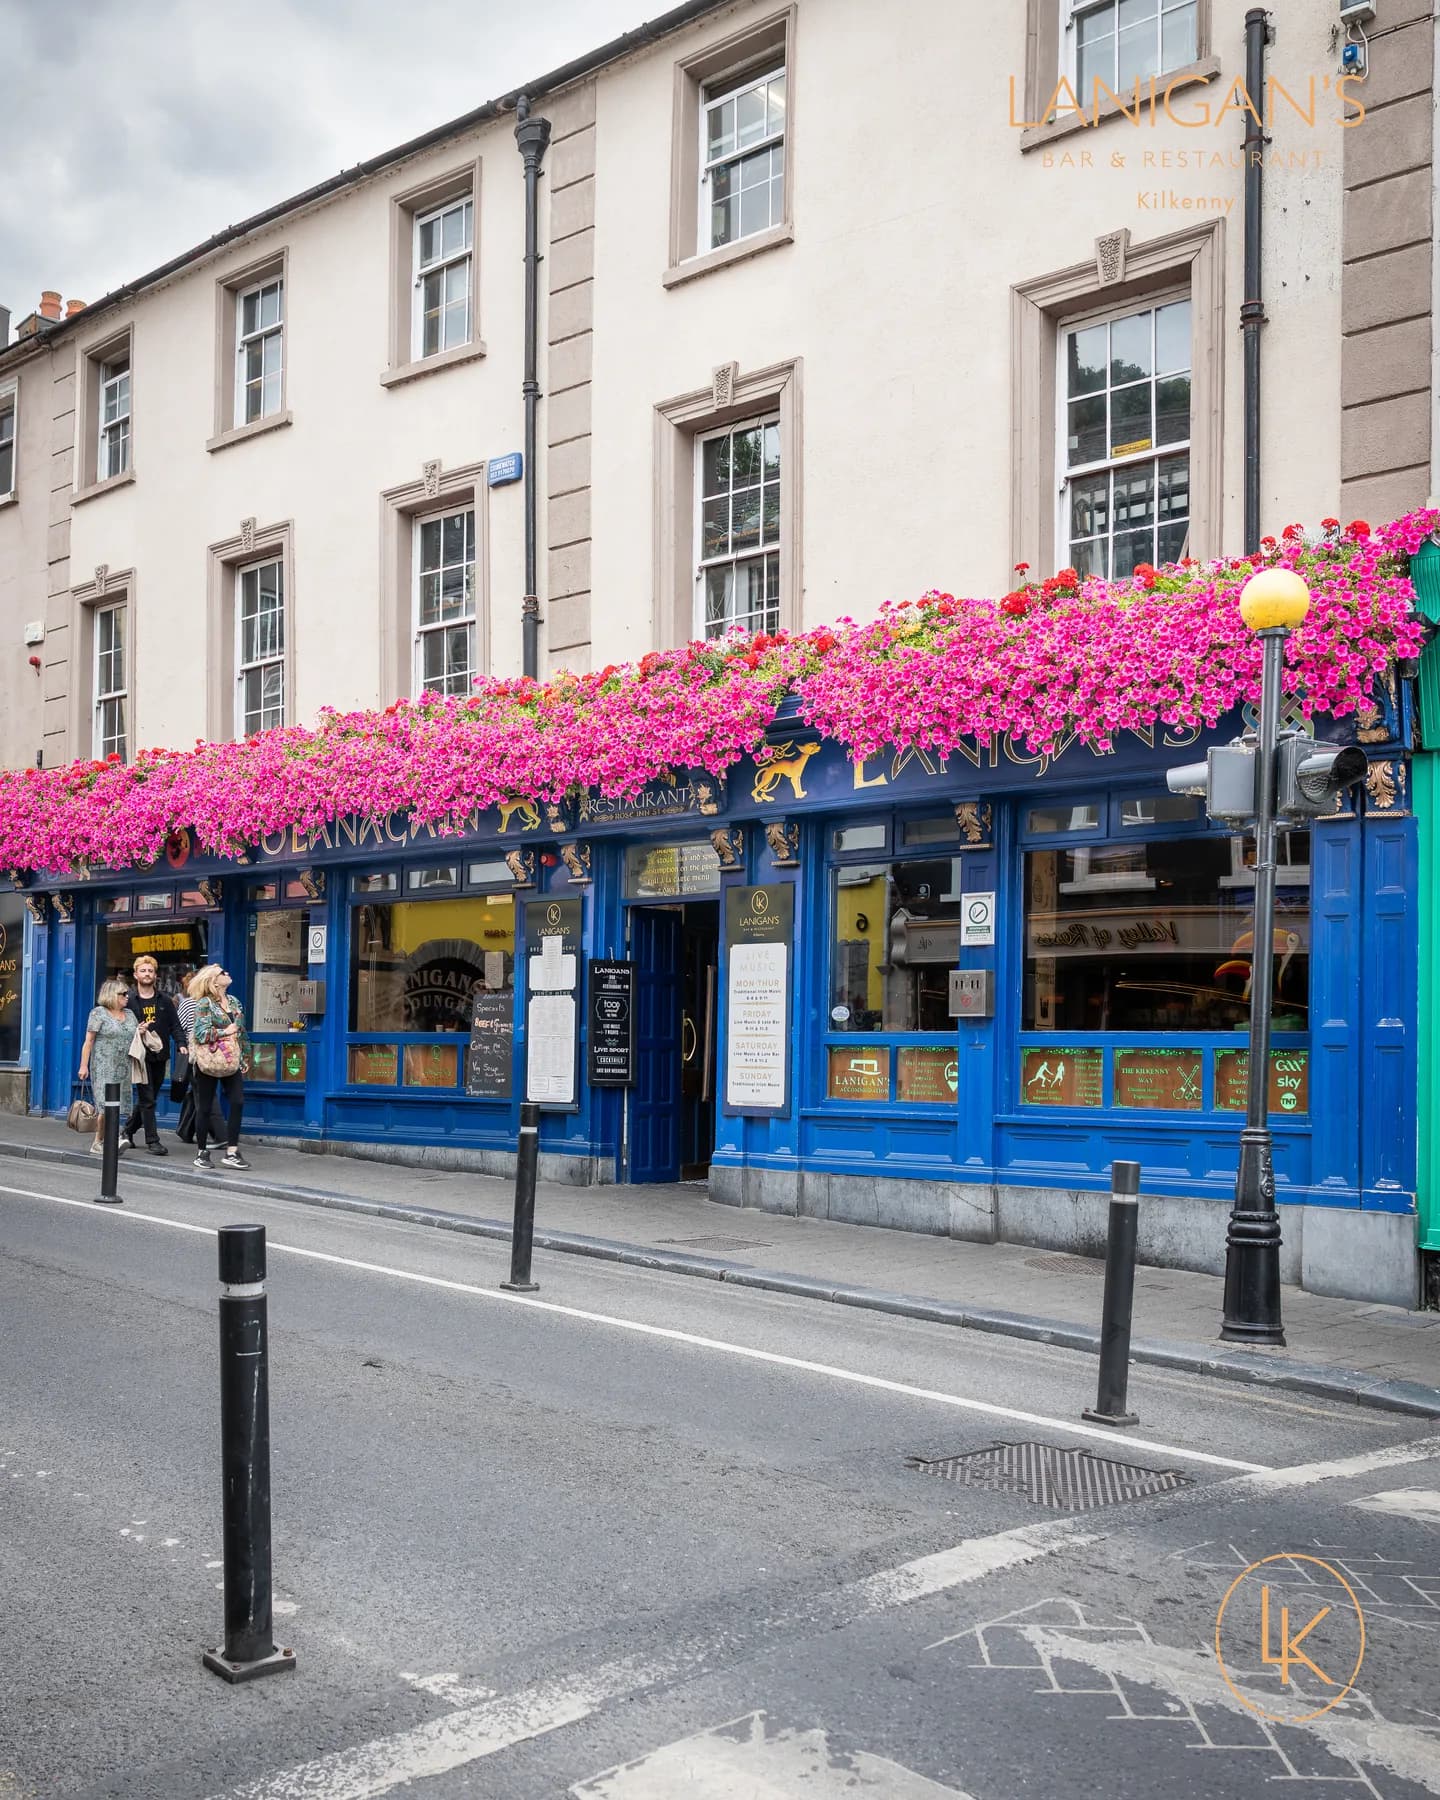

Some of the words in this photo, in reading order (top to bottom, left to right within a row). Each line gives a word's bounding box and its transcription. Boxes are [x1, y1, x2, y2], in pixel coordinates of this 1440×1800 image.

[588, 787, 689, 814] RESTAURANT
[739, 915, 780, 927] LANIGAN'S
[537, 926, 570, 936] LANIGAN'S
[743, 1010, 771, 1018] FRIDAY
[735, 1041, 778, 1050] SATURDAY
[739, 1072, 772, 1080] SUNDAY
[1277, 1074, 1302, 1090] sky
[1281, 1097, 1297, 1105] TNT
